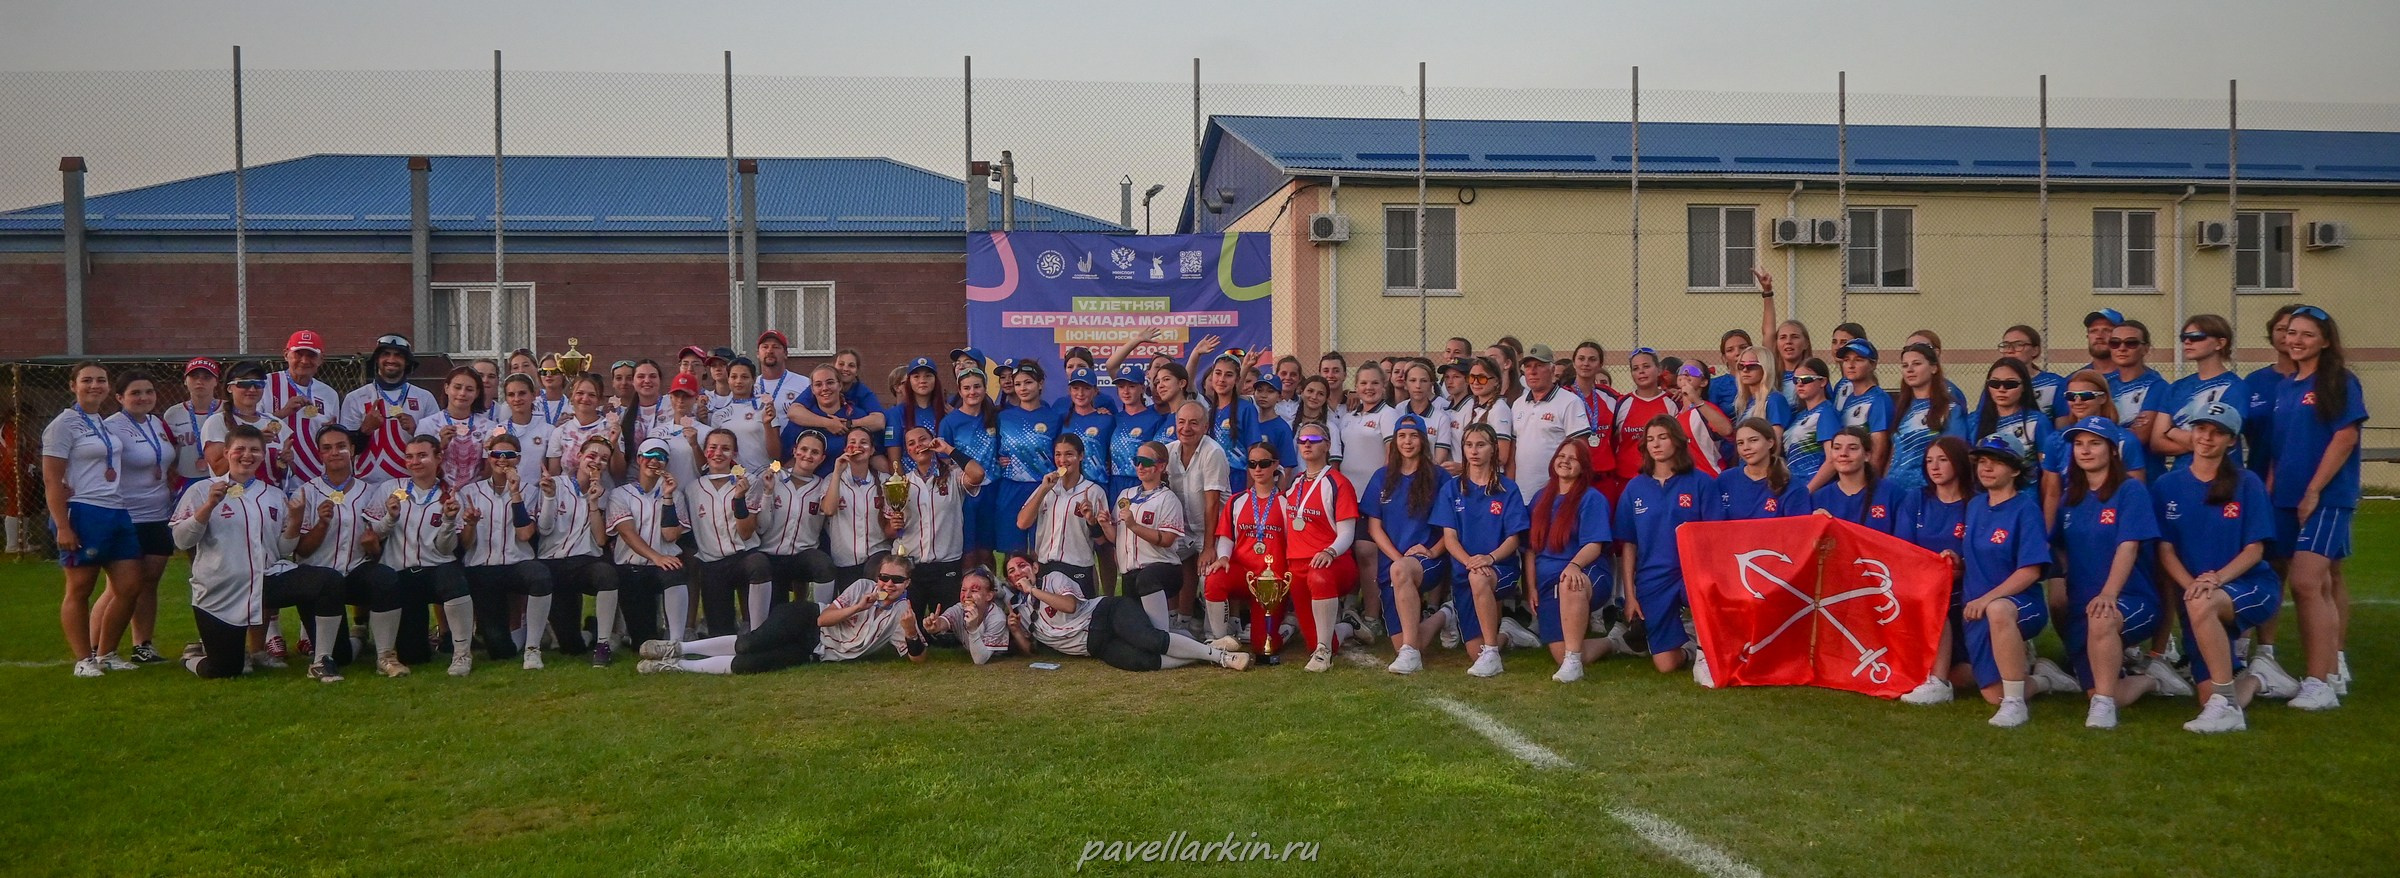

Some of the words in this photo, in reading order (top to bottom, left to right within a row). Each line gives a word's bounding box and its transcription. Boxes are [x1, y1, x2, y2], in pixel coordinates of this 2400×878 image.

[1078, 300, 1097, 311] VI
[1100, 300, 1166, 311] ЛЕТНЯЯ
[1010, 315, 1136, 328] СПАРТАКИАДА
[1138, 314, 1231, 327] МОЛОДЕЖИ
[1136, 345, 1178, 356] 2025
